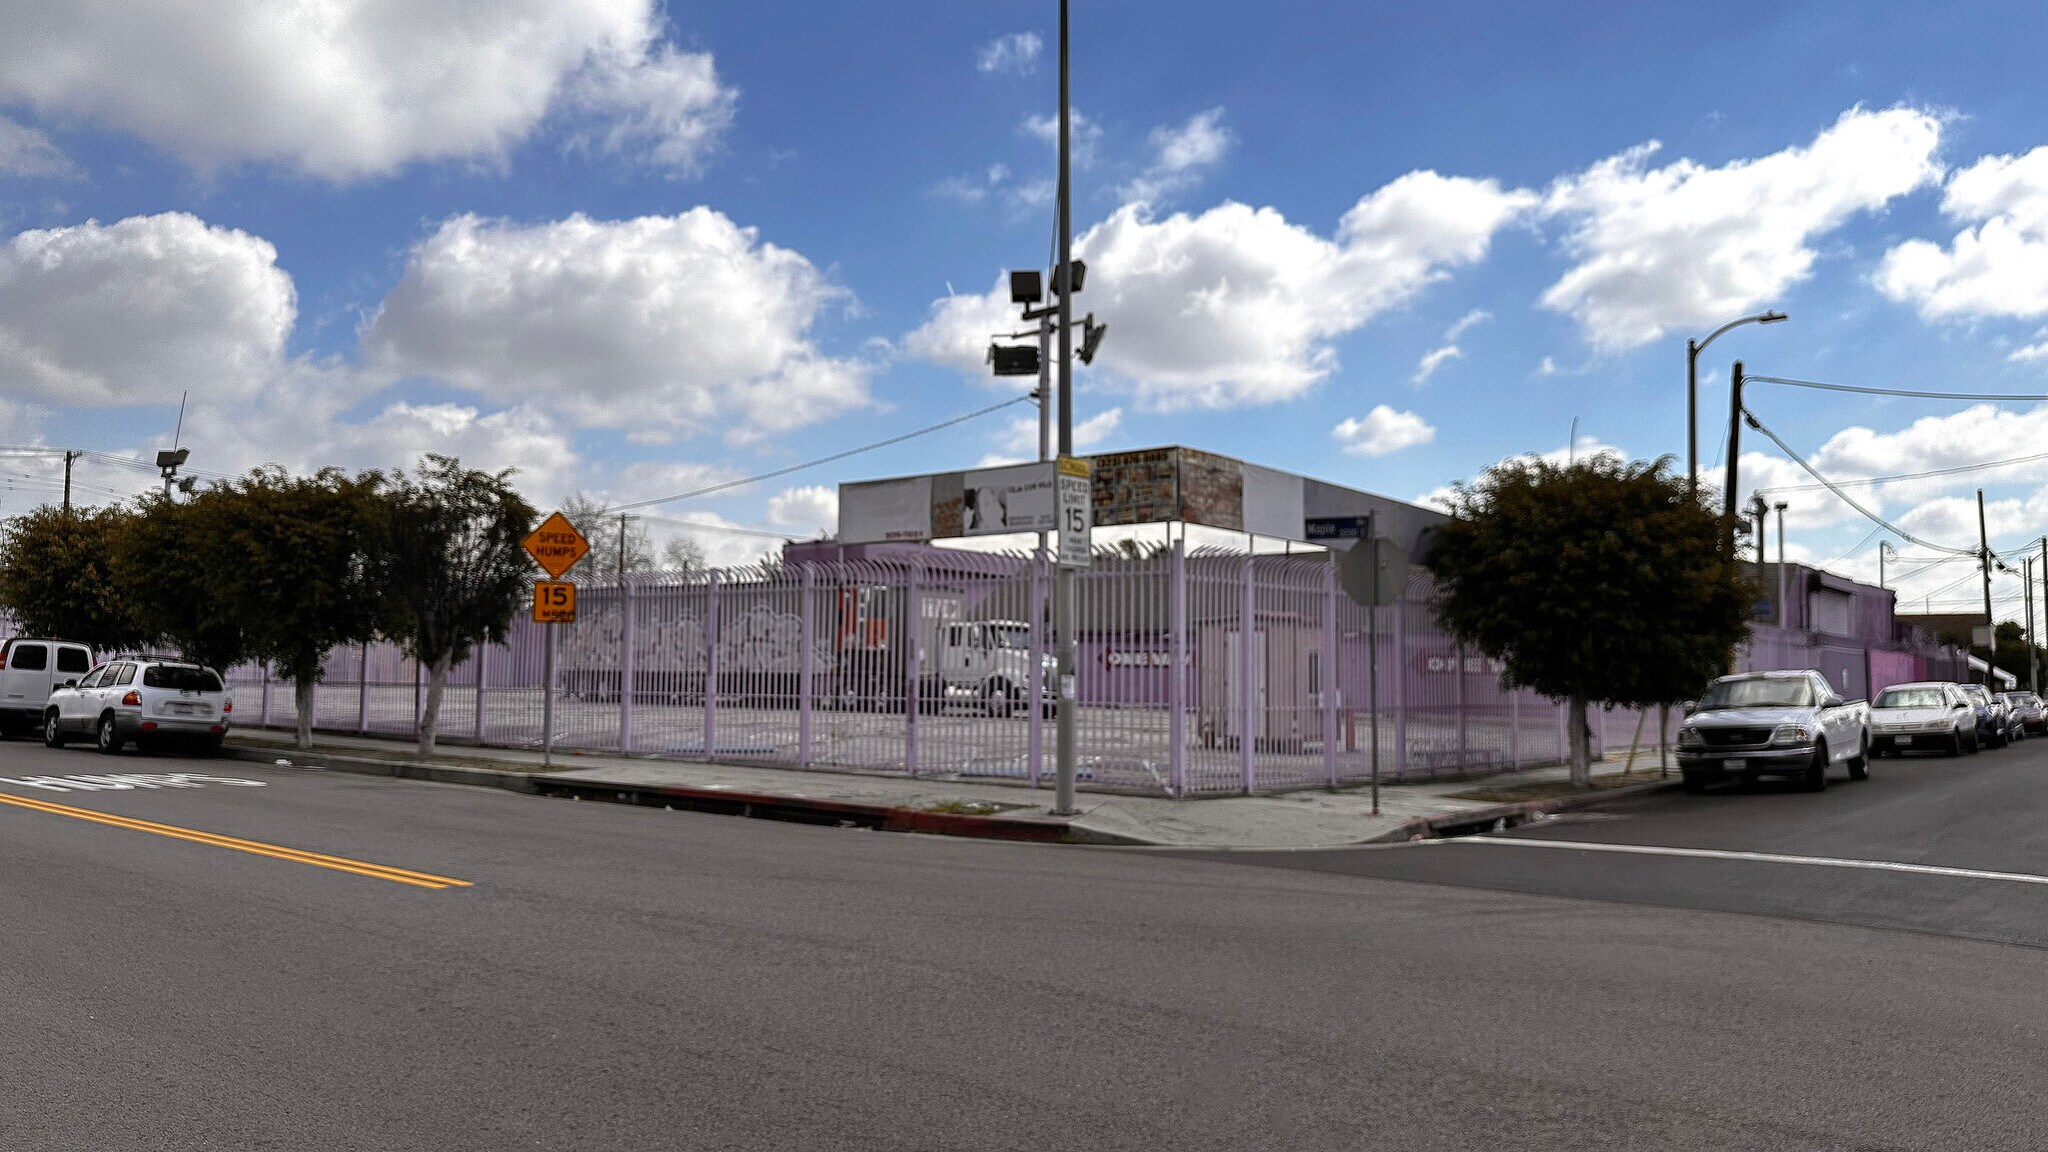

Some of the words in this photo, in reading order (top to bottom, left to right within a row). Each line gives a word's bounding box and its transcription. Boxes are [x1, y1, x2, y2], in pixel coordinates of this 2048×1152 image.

[1061, 478, 1088, 493] SPEED
[1065, 506, 1085, 532] 15
[1307, 522, 1337, 536] Maple
[539, 532, 576, 545] SPEED
[536, 546, 577, 559] HUMPS
[543, 586, 567, 606] 15
